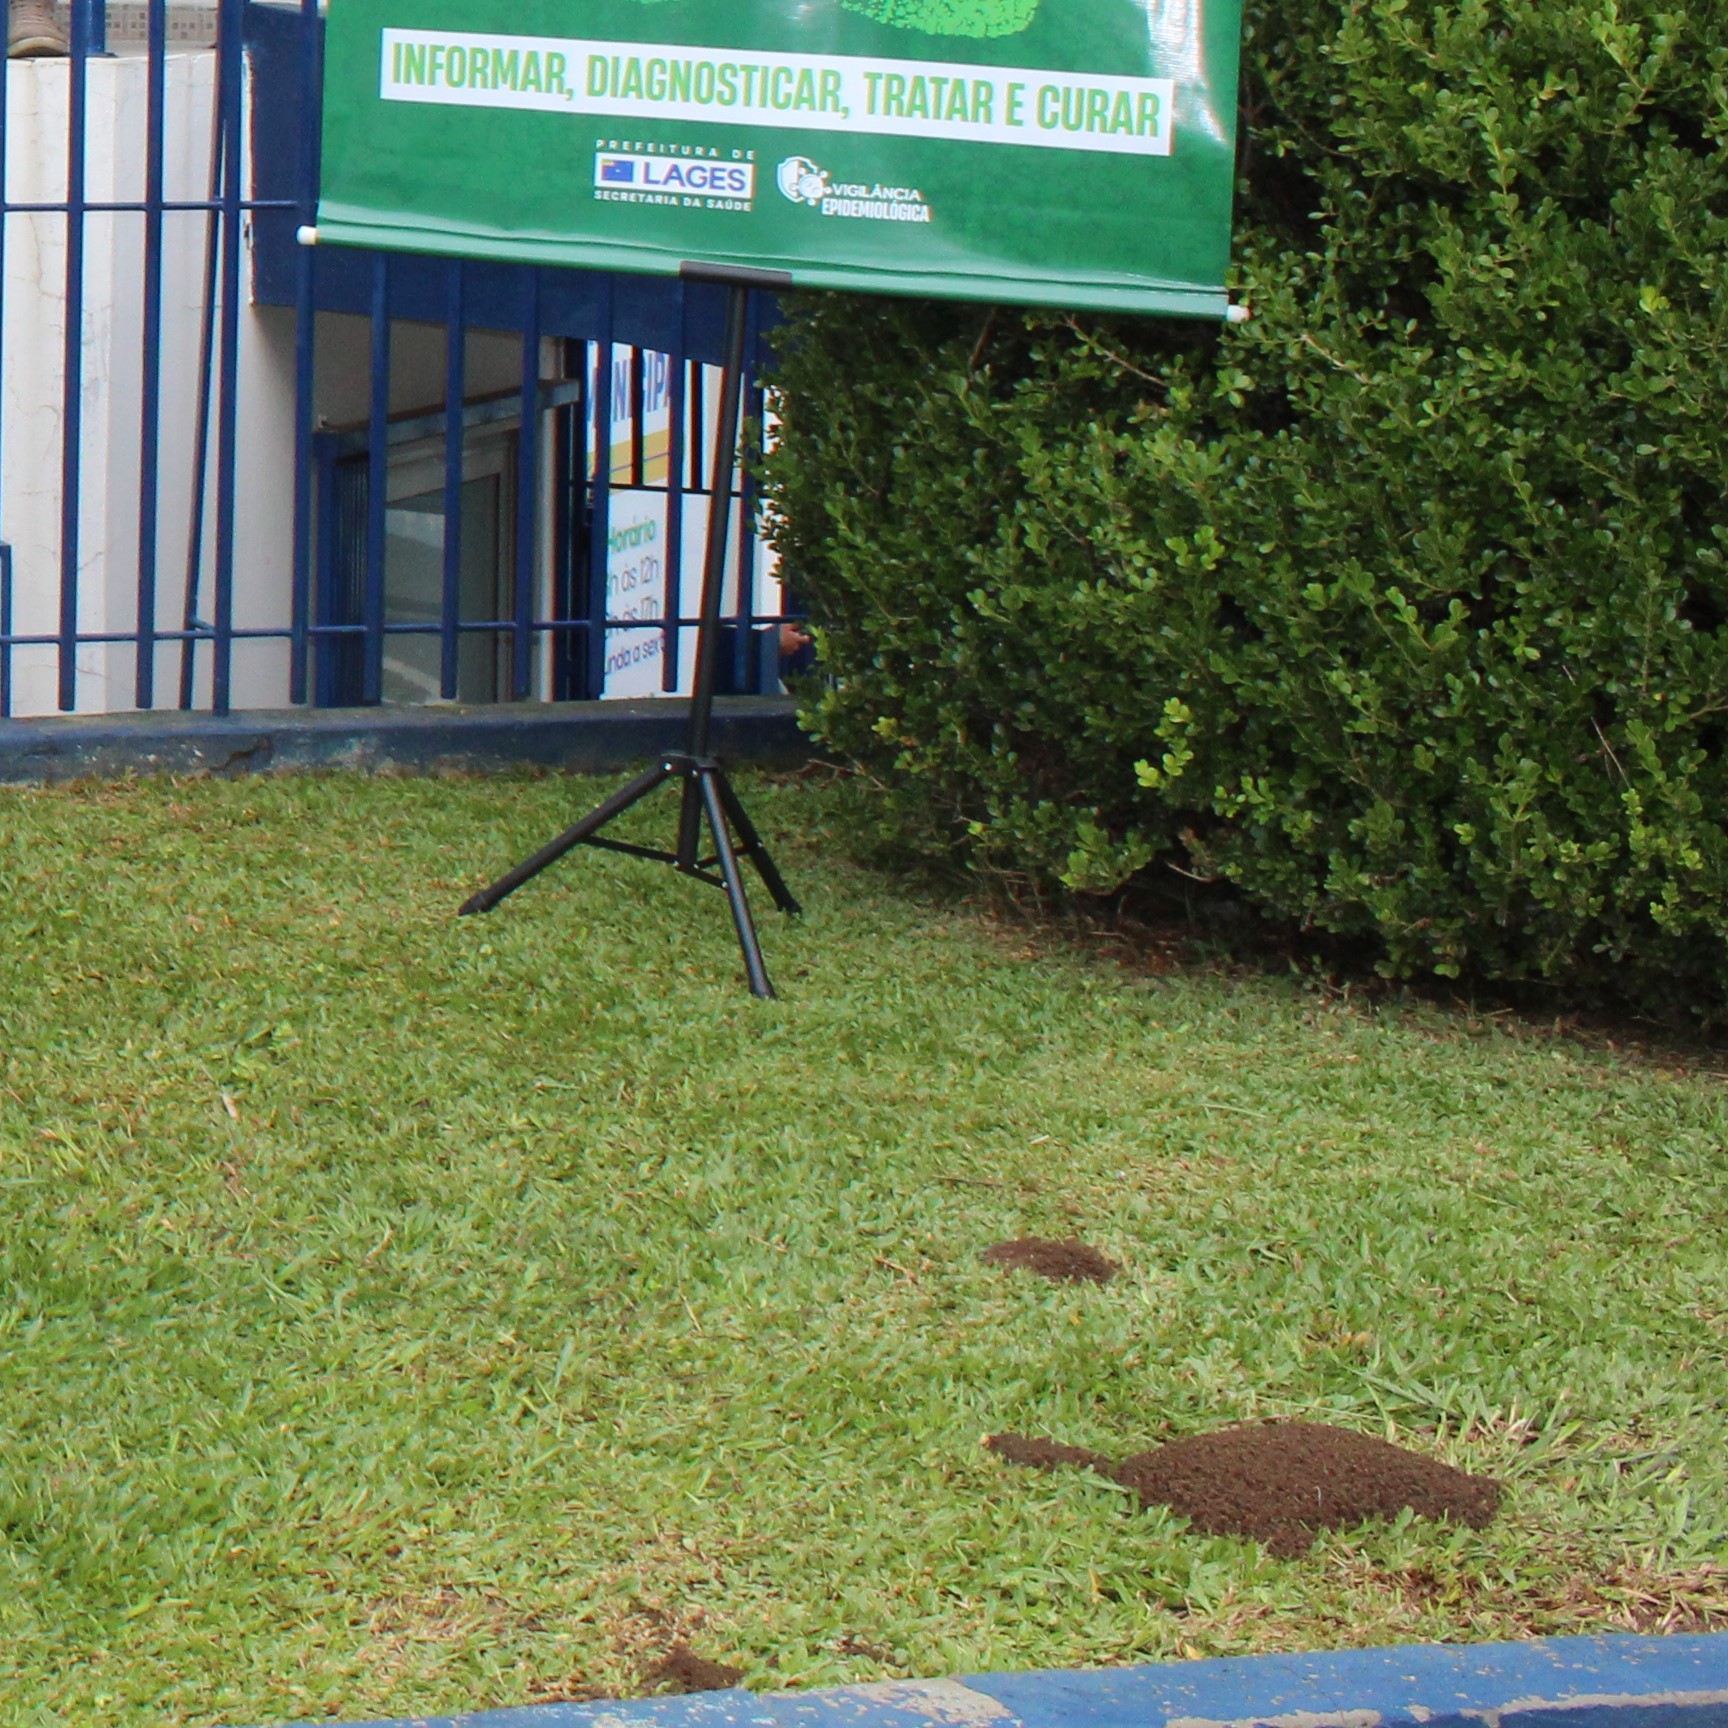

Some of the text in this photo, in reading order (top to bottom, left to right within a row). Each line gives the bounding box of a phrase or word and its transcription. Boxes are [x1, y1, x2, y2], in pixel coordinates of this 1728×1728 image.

[391, 42, 1160, 138] INFORMAR, DIAGNOSTICAR, TRATAR E CURAR
[595, 138, 756, 161] PREFEITURA DE
[644, 161, 747, 192] LAGES
[594, 189, 754, 213] SECRETARIA DA SAÚDE
[831, 182, 924, 203] VIGILÂNCIA
[821, 197, 932, 223] EPIDEMIOLÓGICA
